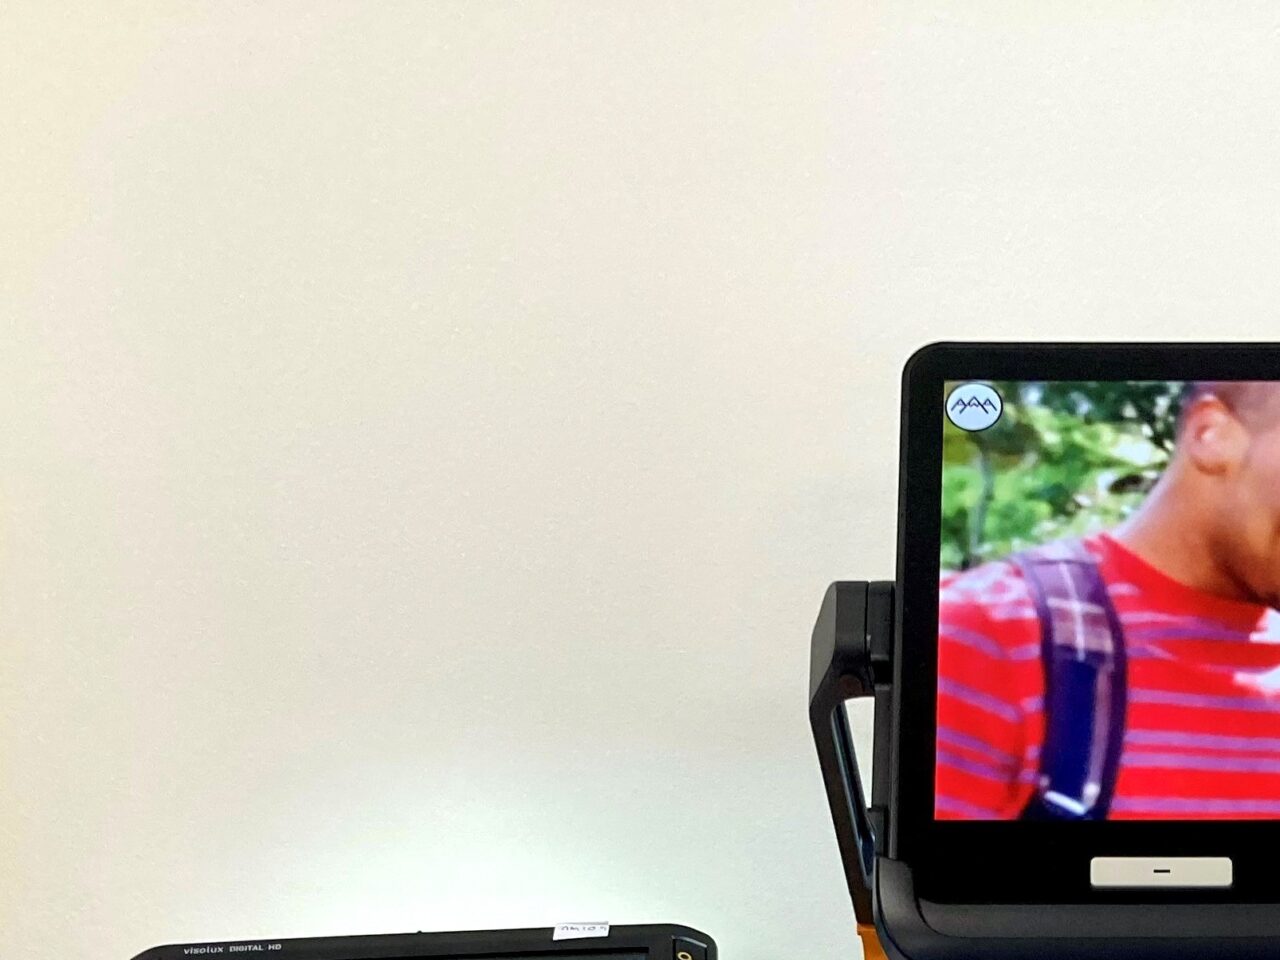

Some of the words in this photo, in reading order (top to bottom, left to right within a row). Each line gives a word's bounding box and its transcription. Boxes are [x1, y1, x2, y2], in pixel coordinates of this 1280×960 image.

[183, 946, 224, 955] visolux
[229, 944, 263, 952] DIGITAL
[268, 943, 282, 951] HD
